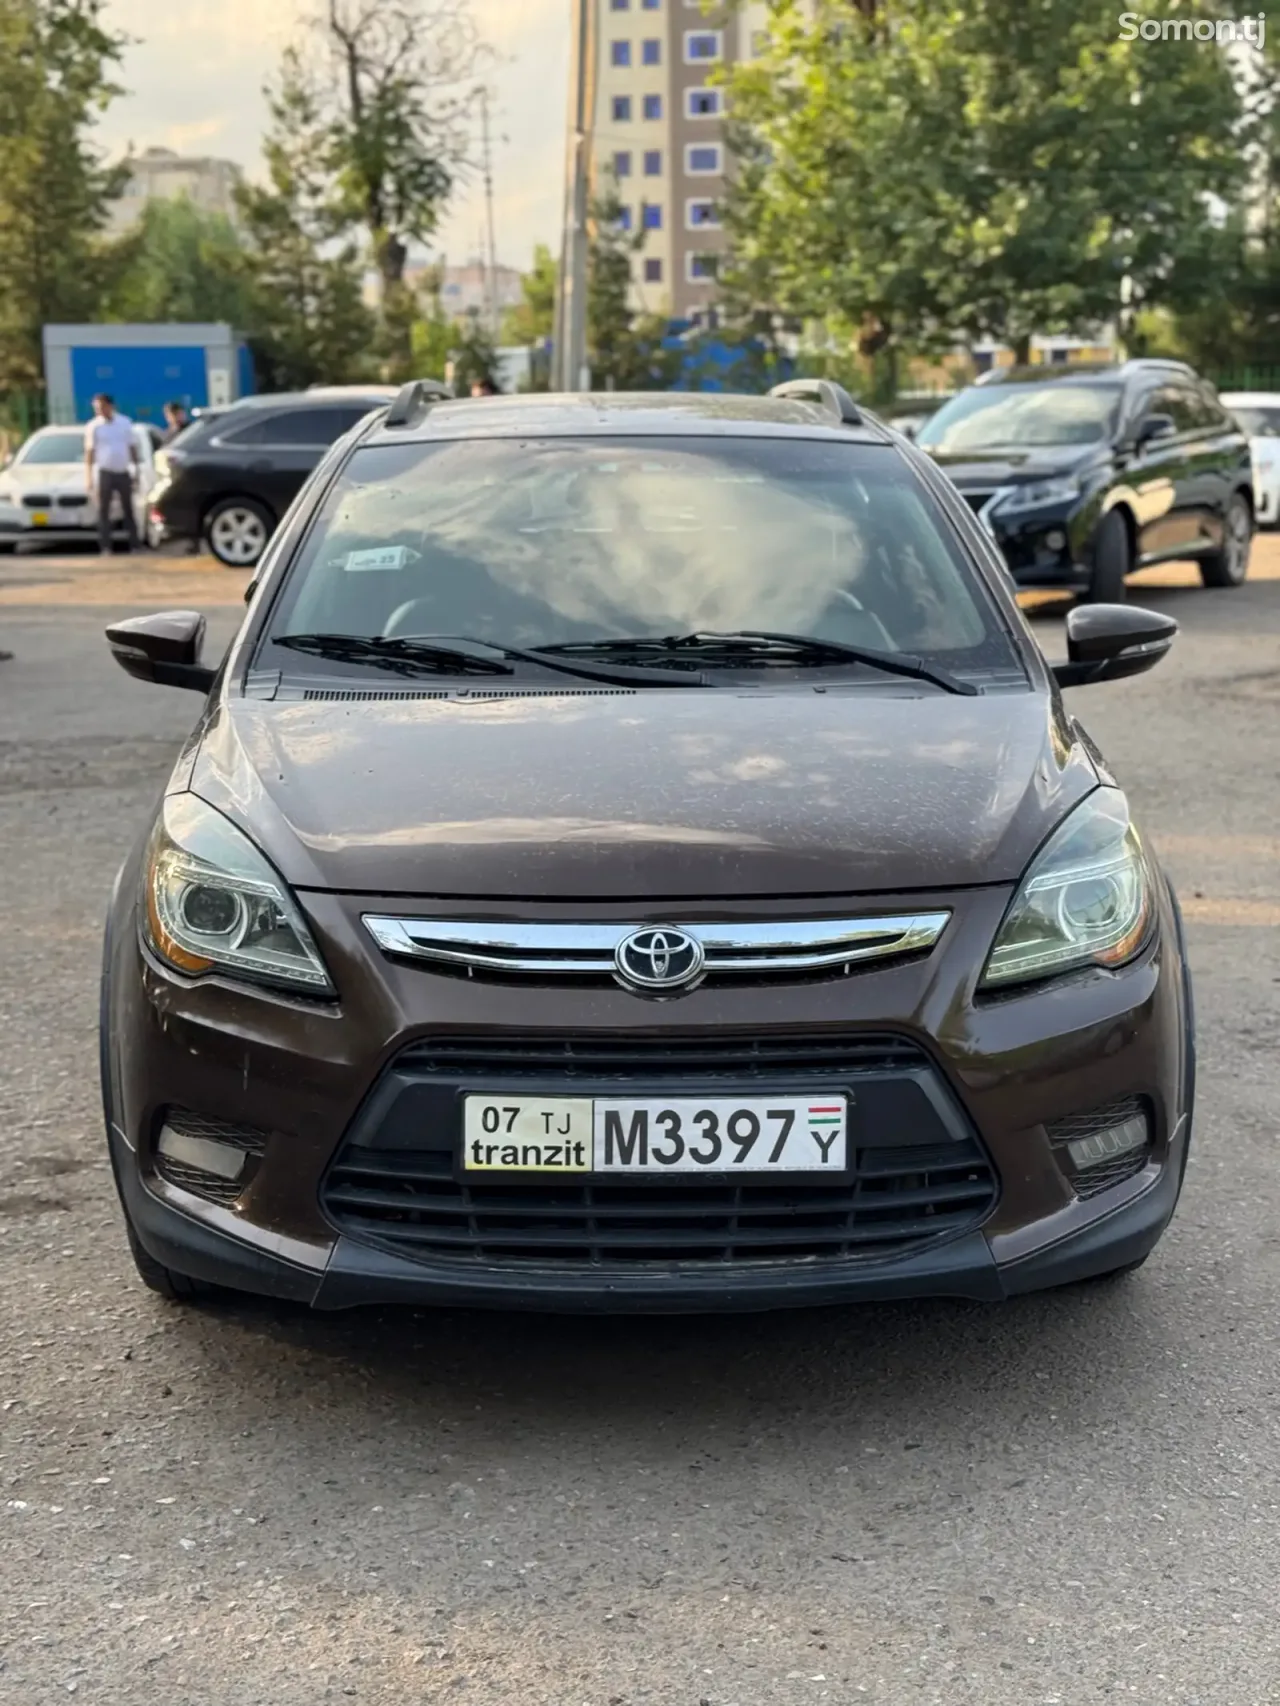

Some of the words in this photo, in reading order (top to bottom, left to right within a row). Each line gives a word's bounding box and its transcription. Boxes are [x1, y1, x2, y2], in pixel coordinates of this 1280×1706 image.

[481, 1106, 521, 1134] 07
[540, 1111, 571, 1135] TJ
[604, 1108, 797, 1166] M3397
[810, 1130, 840, 1164] Y
[470, 1138, 586, 1167] tranzit
